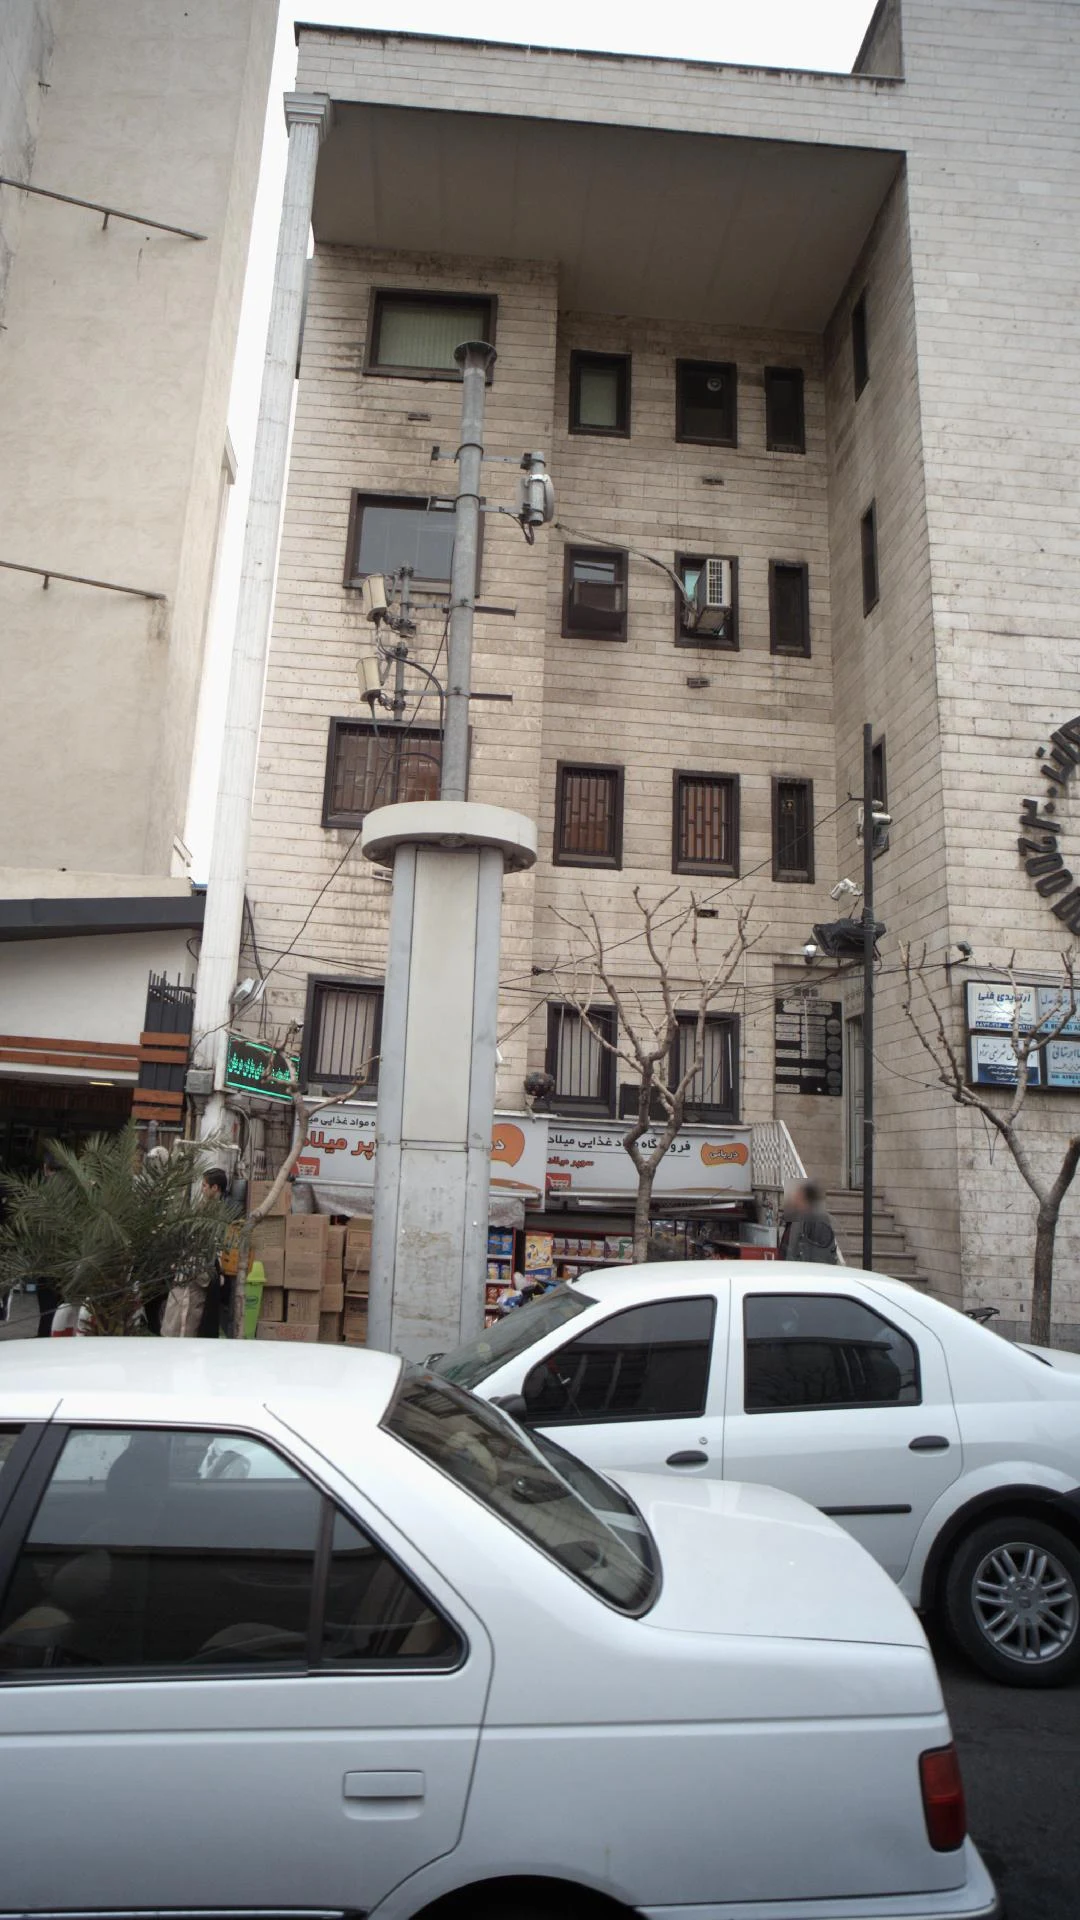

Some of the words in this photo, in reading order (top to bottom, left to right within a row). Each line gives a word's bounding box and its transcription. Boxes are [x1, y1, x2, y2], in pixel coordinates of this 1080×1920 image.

[320, 1115, 348, 1126] غذایی
[350, 1117, 369, 1128] مواد
[547, 1133, 575, 1147] میلاد
[578, 1135, 613, 1149] غذایی
[641, 1137, 691, 1153] فروگاه
